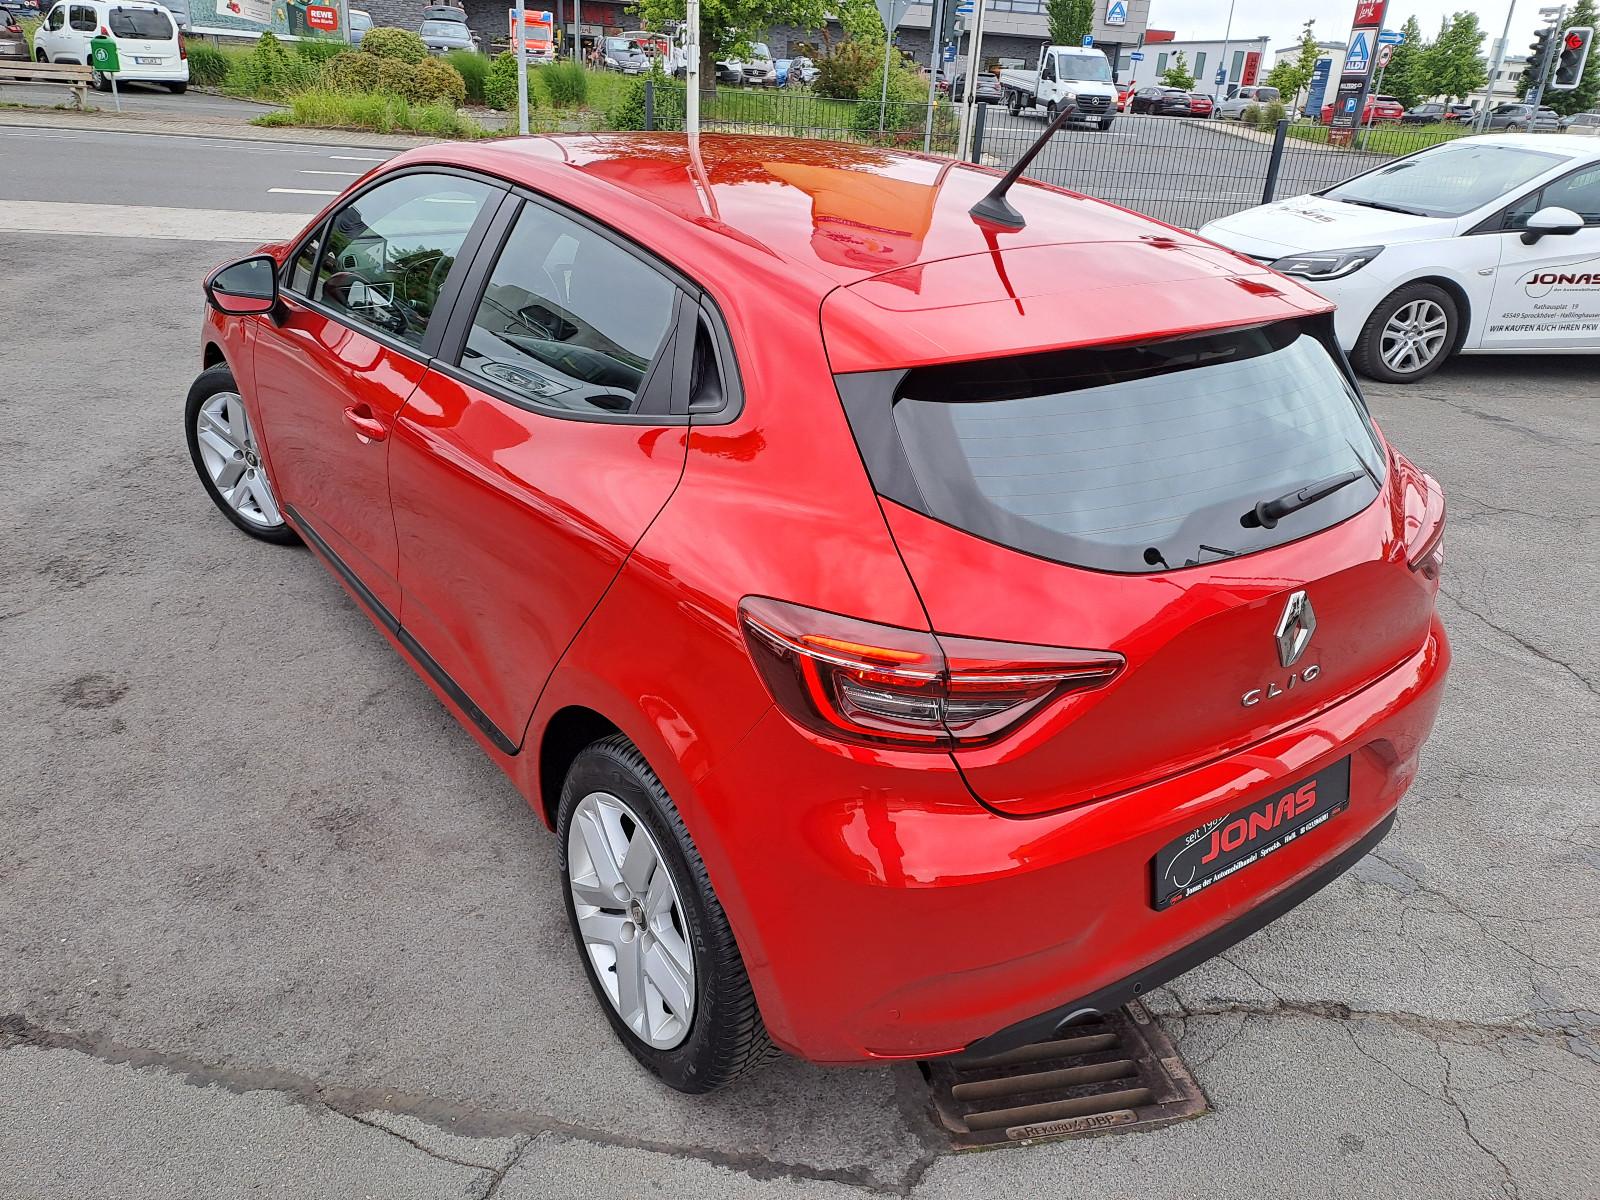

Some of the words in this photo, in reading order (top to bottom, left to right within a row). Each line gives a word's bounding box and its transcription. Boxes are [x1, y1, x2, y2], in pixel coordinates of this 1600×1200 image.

[310, 10, 333, 18] REWE
[1085, 36, 1092, 44] P
[1346, 61, 1365, 70] ALDI
[1348, 99, 1355, 110] P
[1526, 273, 1600, 285] JONAS
[1520, 312, 1556, 320] Sprockhövel
[1504, 324, 1535, 332] KAUFEN
[1241, 665, 1321, 706] CLIO
[1202, 780, 1317, 864] JONAS
[1185, 829, 1201, 846] seit
[1202, 877, 1213, 887] der
[1214, 853, 1258, 882] Automobilhandel
[1087, 1115, 1115, 1127] DBP
